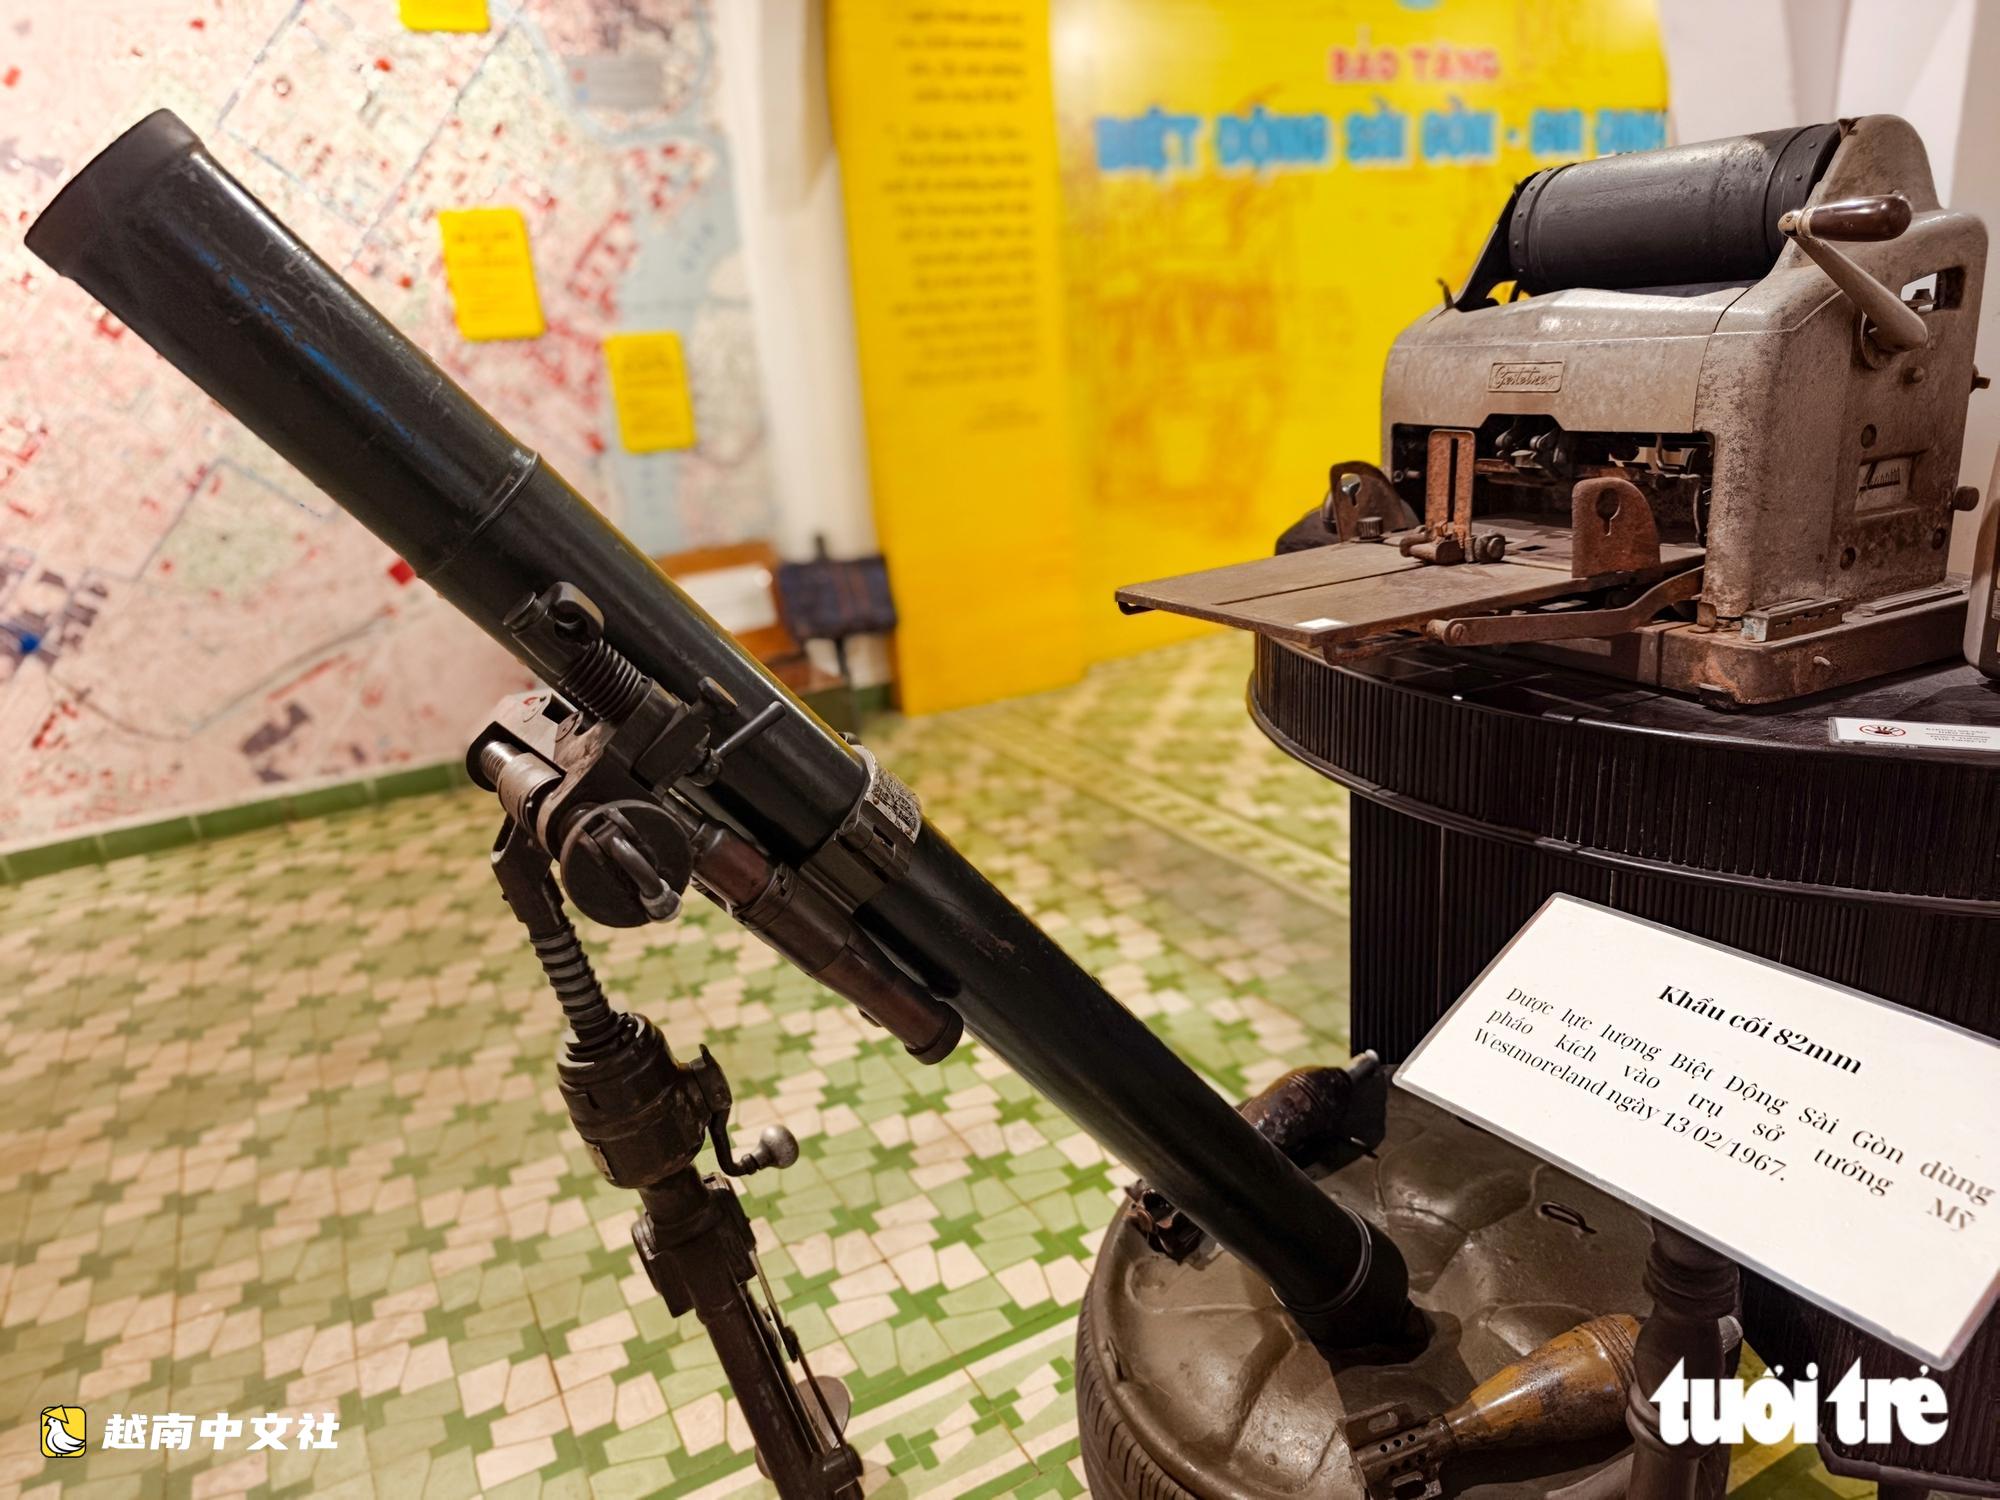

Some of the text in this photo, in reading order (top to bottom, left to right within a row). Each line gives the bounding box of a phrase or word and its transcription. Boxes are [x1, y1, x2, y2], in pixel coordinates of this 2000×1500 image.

[1474, 1028, 1787, 1182] Westmoreland ngày 13/02/1967.
[1560, 1008, 1593, 1031] lực
[1600, 1024, 1662, 1062] lượng
[1669, 1052, 1716, 1082] Biệt
[1798, 1107, 1840, 1135] Sài
[1853, 1130, 1905, 1165] Gòn
[1919, 1160, 1996, 1207] dùng
[1657, 985, 1862, 1075] Khẩu cối 82mm
[1486, 1009, 1977, 1232] pháo kích vào trụ sở tướng Mỹ
